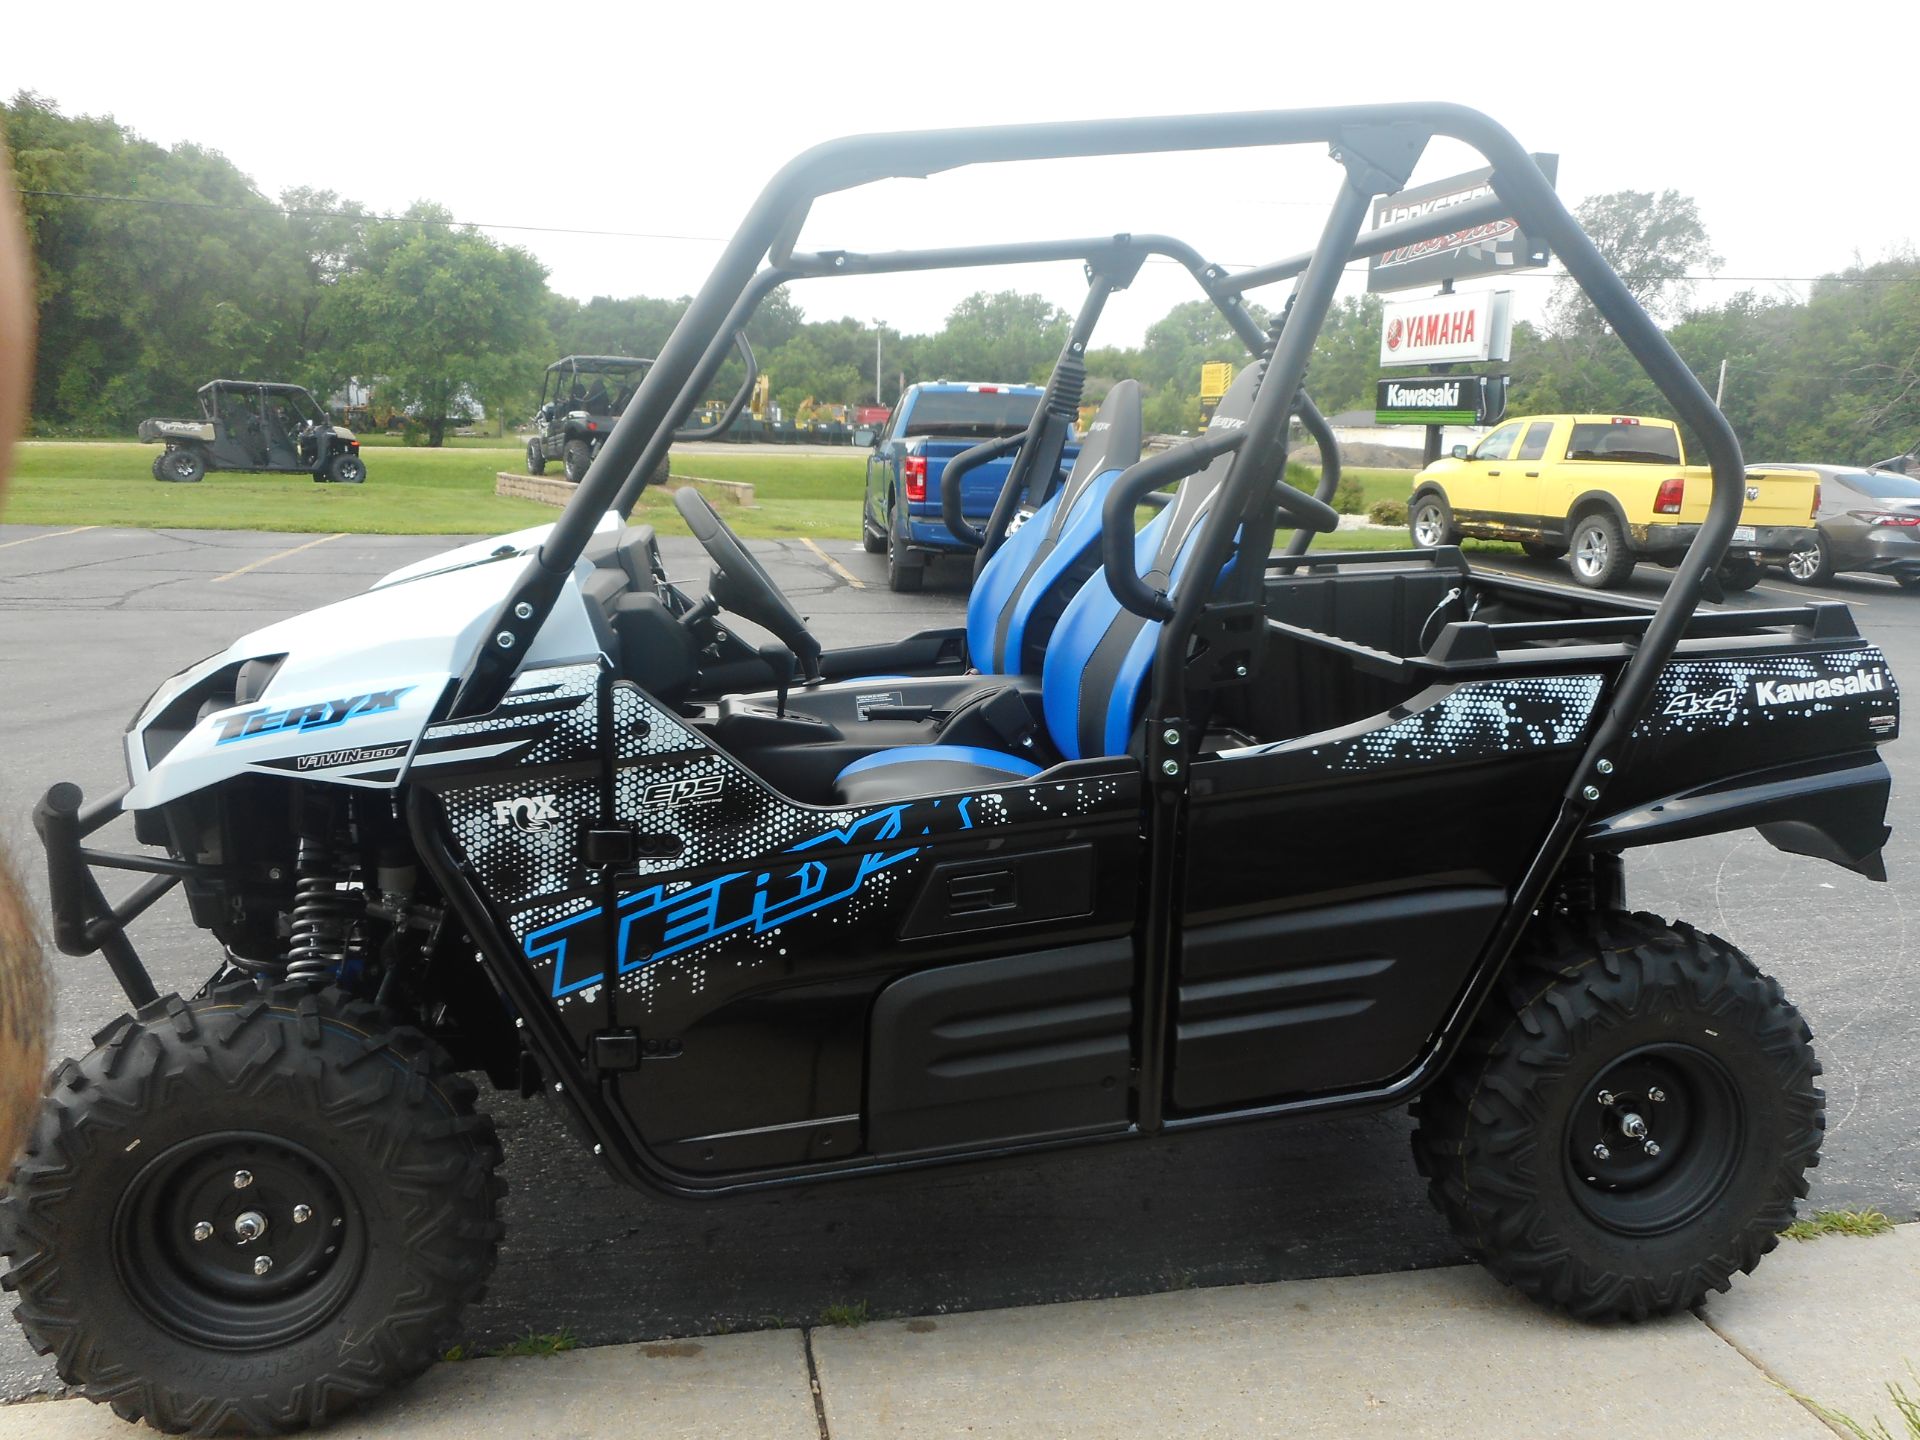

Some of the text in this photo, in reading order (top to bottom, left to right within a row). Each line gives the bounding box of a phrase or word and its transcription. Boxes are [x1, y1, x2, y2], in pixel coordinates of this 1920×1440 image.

[1406, 309, 1475, 348] YAMAHA
[1387, 382, 1460, 407] Kawasaki
[1755, 667, 1883, 706] Kawasaki
[211, 685, 419, 746] TERYX
[642, 775, 724, 805] EPS
[493, 794, 560, 833] FOX
